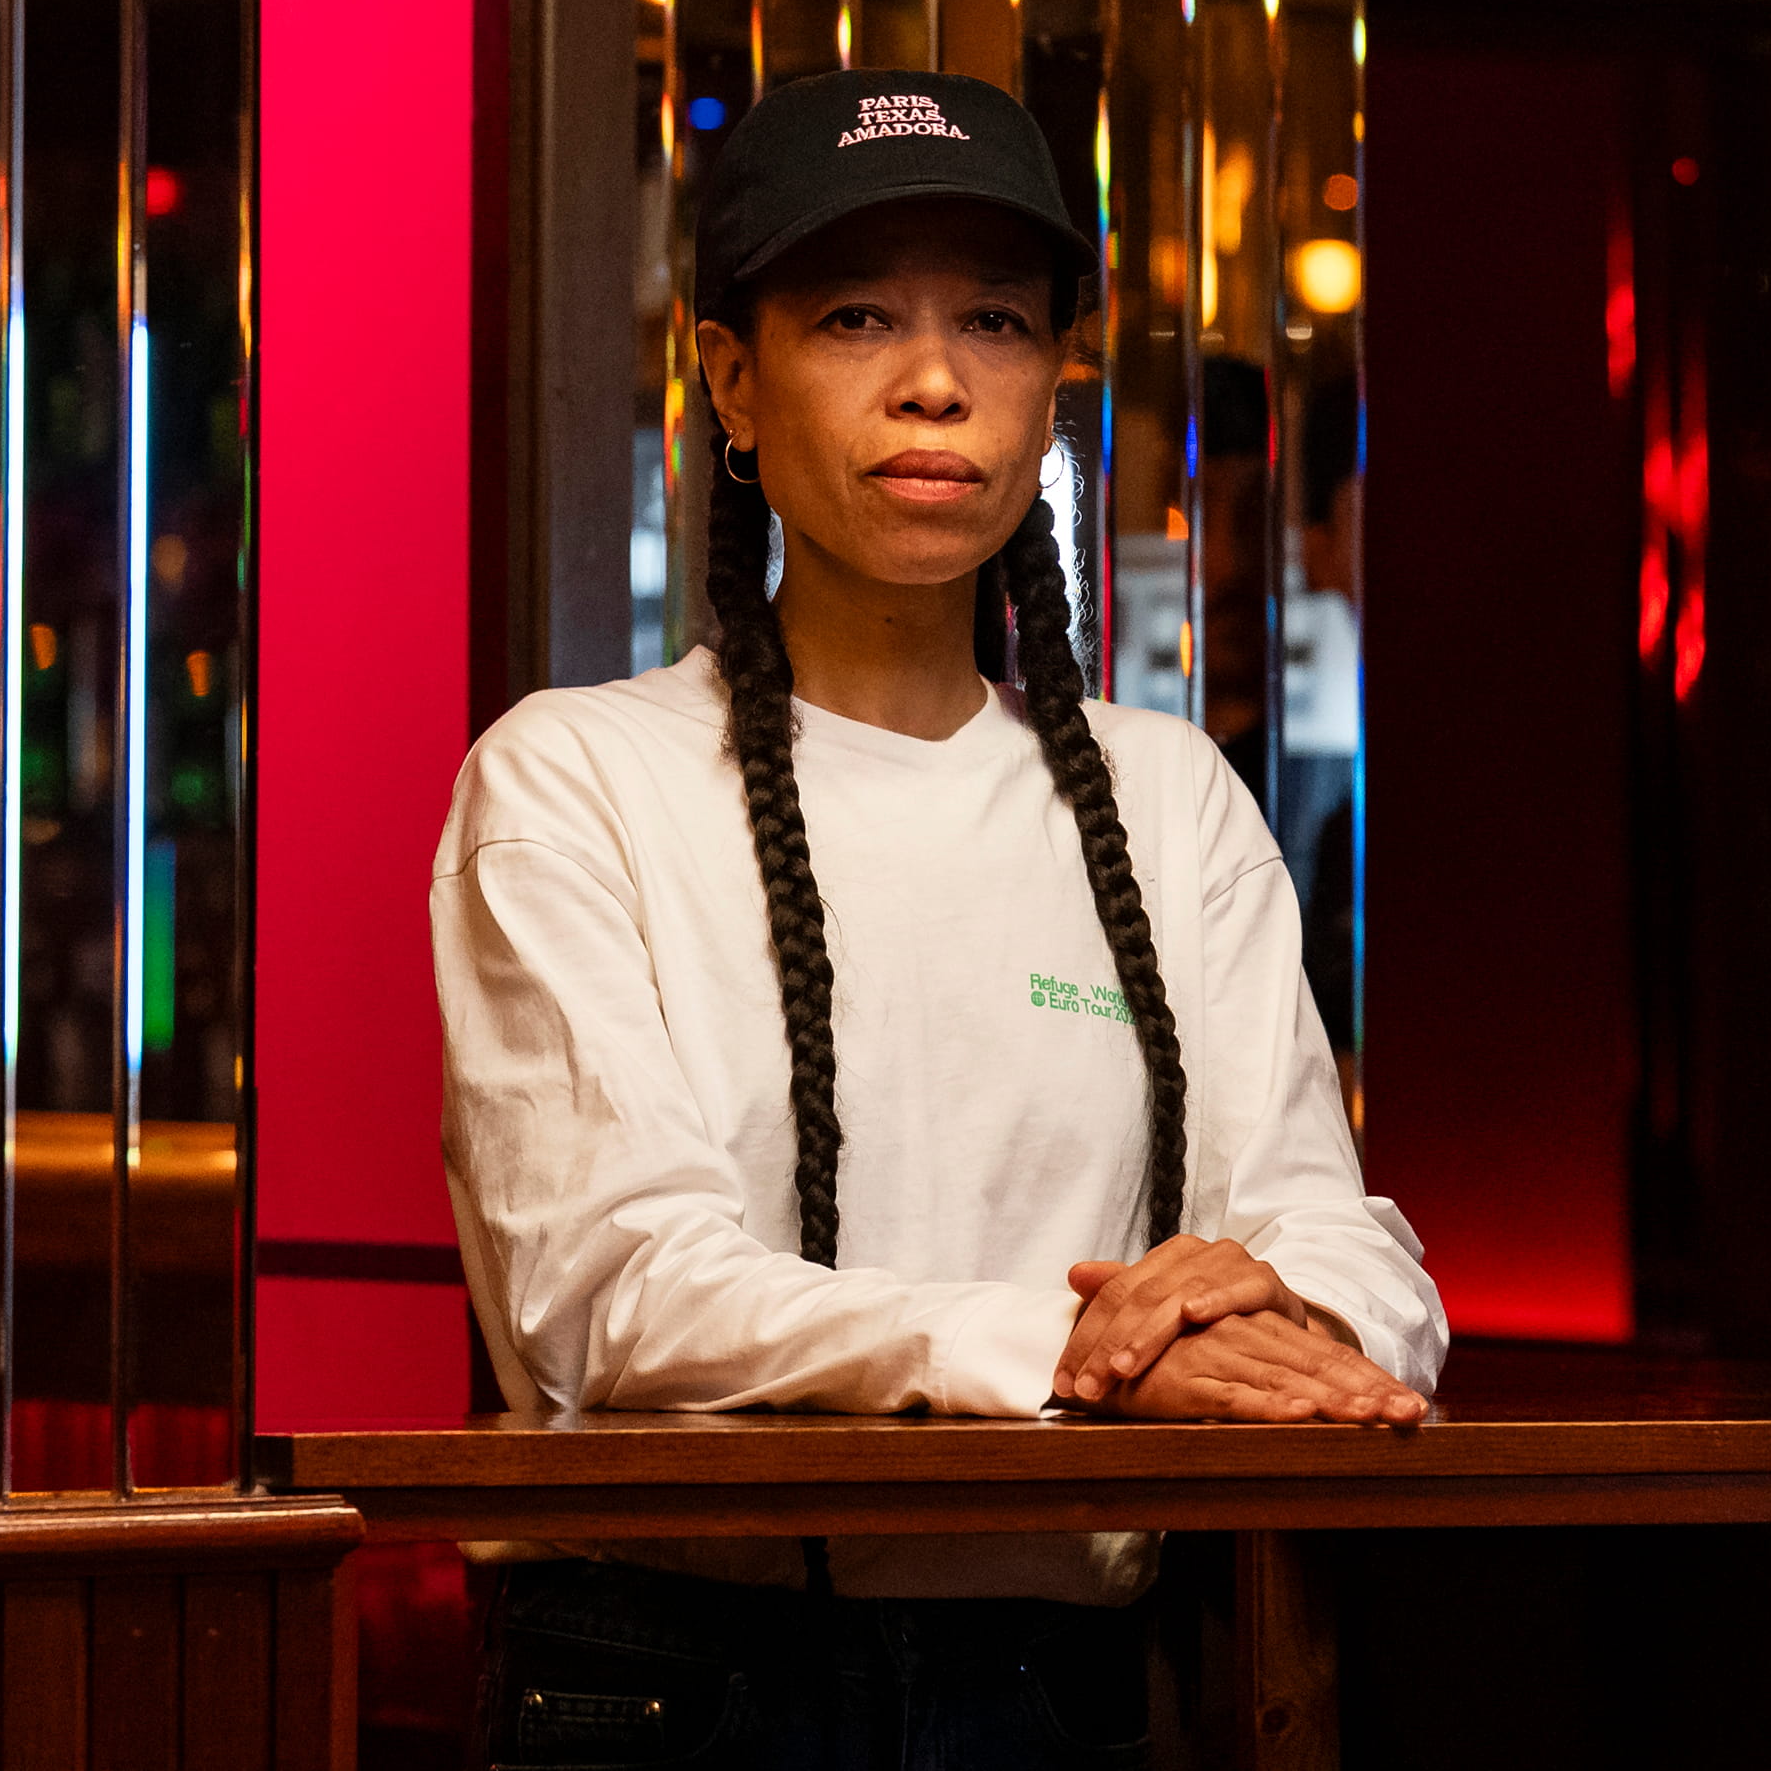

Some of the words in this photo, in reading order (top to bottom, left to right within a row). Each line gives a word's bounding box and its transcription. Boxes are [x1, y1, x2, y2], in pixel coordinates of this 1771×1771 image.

[859, 95, 939, 111] PARIS,
[858, 109, 946, 126] TEXAS,
[837, 123, 970, 147] AMADORA.
[1030, 974, 1078, 999] Refuge
[1049, 992, 1079, 1013] Euro
[1080, 998, 1112, 1018] Tour
